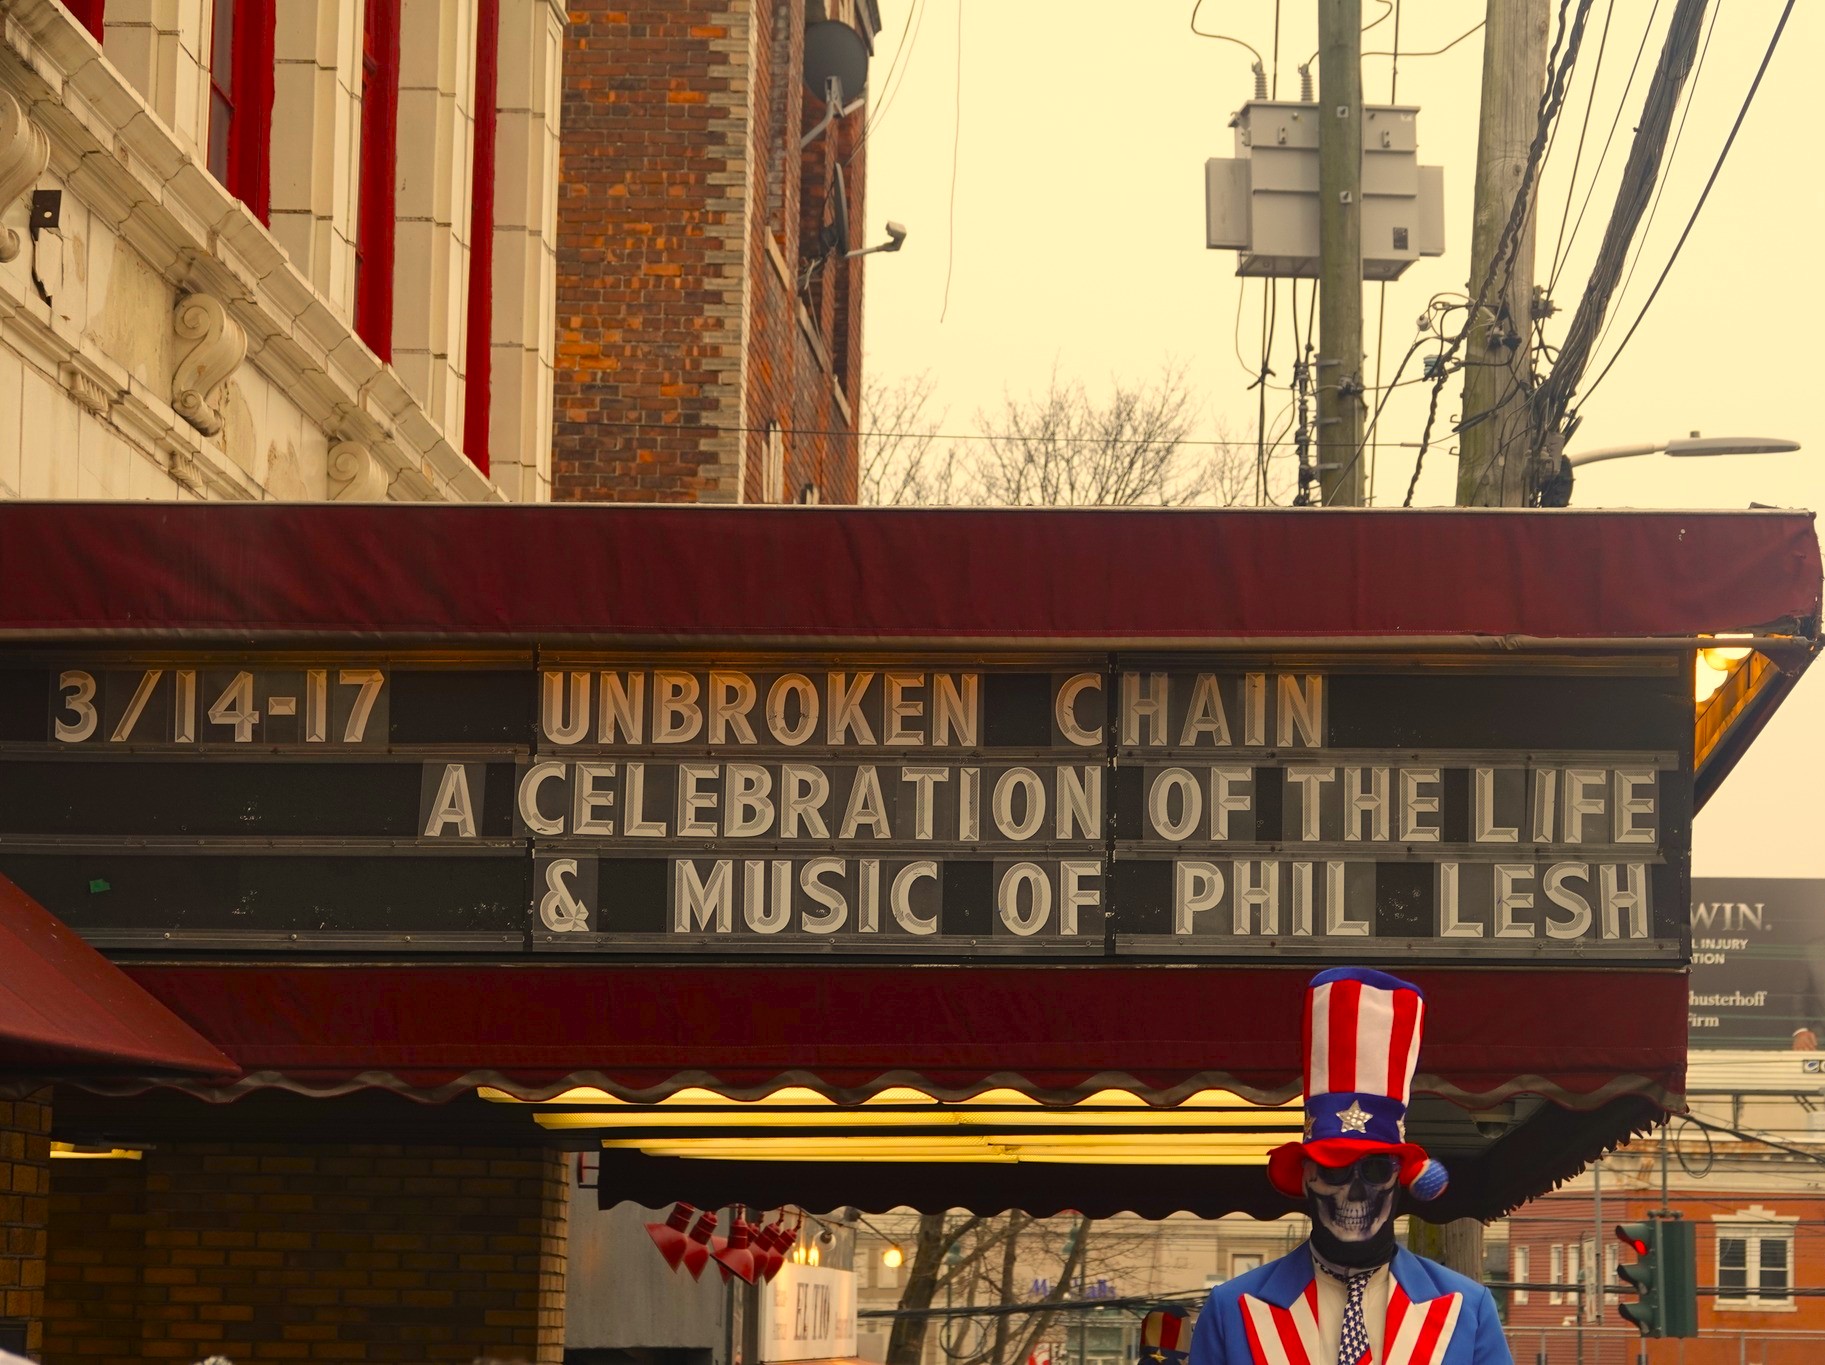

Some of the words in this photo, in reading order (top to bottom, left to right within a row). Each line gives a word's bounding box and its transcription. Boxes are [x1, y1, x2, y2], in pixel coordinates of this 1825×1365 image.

[54, 669, 386, 743] 3/14-17
[542, 670, 978, 747] UNBROKEN
[1054, 672, 1323, 748] CHAIN
[423, 763, 477, 838] A
[517, 761, 1102, 842] CELEBRATION
[1148, 767, 1253, 842] OF
[1287, 767, 1440, 843] THE
[1475, 768, 1656, 844] LIFE
[539, 858, 590, 933] &
[674, 857, 938, 936] MUSIC
[998, 860, 1102, 937] OF
[1174, 860, 1370, 937] PHIL
[1440, 861, 1649, 940] LESH
[1690, 953, 1726, 965] TION
[1701, 938, 1750, 950] INJURY
[1688, 990, 1768, 1007] husterhoff
